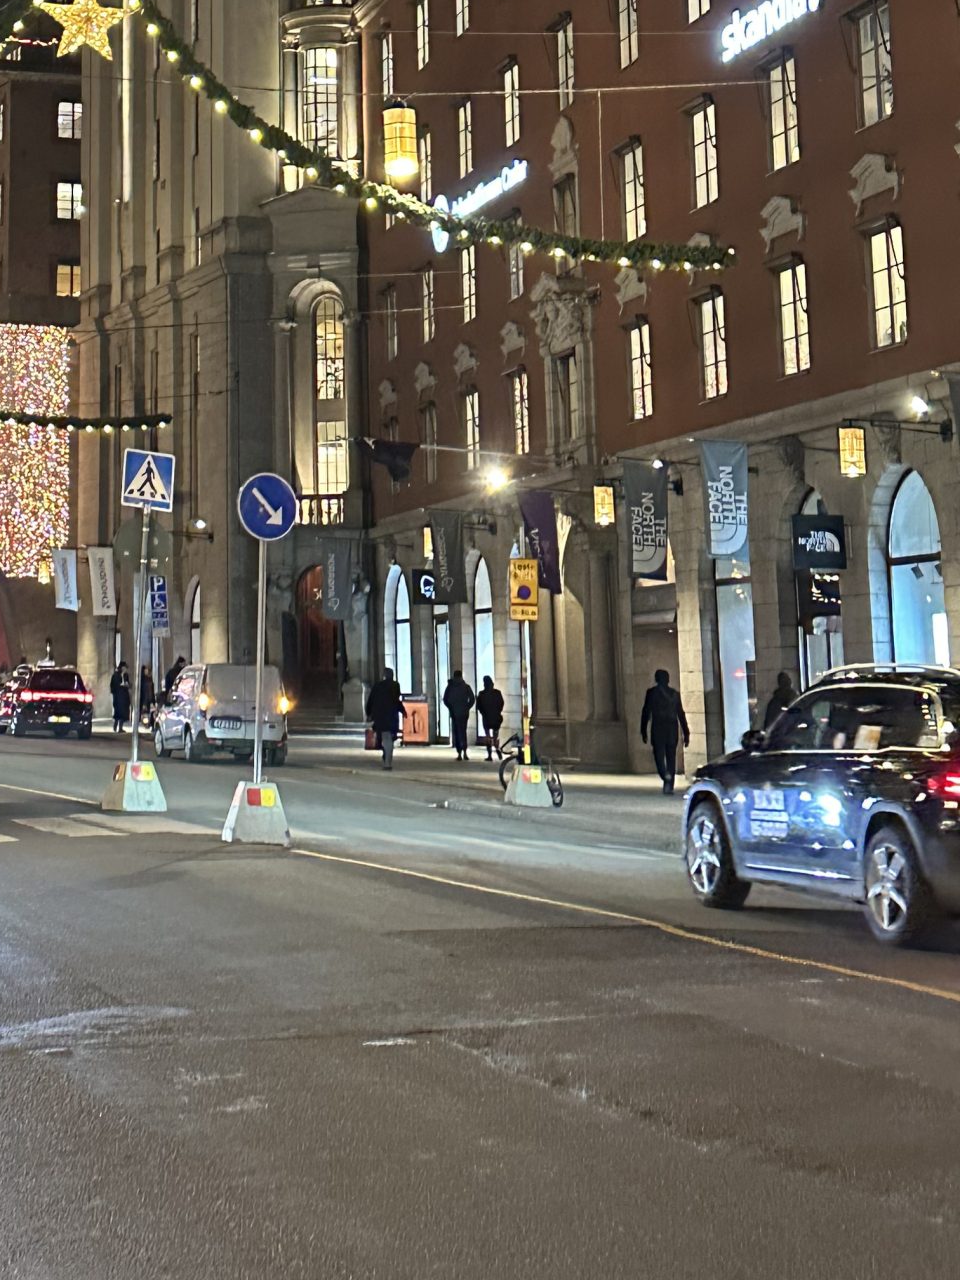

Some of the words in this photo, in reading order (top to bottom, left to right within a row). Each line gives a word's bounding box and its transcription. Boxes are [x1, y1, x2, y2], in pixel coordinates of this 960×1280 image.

[707, 480, 723, 524] FACE
[718, 465, 737, 525] NORTH
[735, 491, 747, 526] THE
[631, 506, 644, 549] FACE
[641, 492, 655, 546] NORTH
[654, 517, 667, 548] THE
